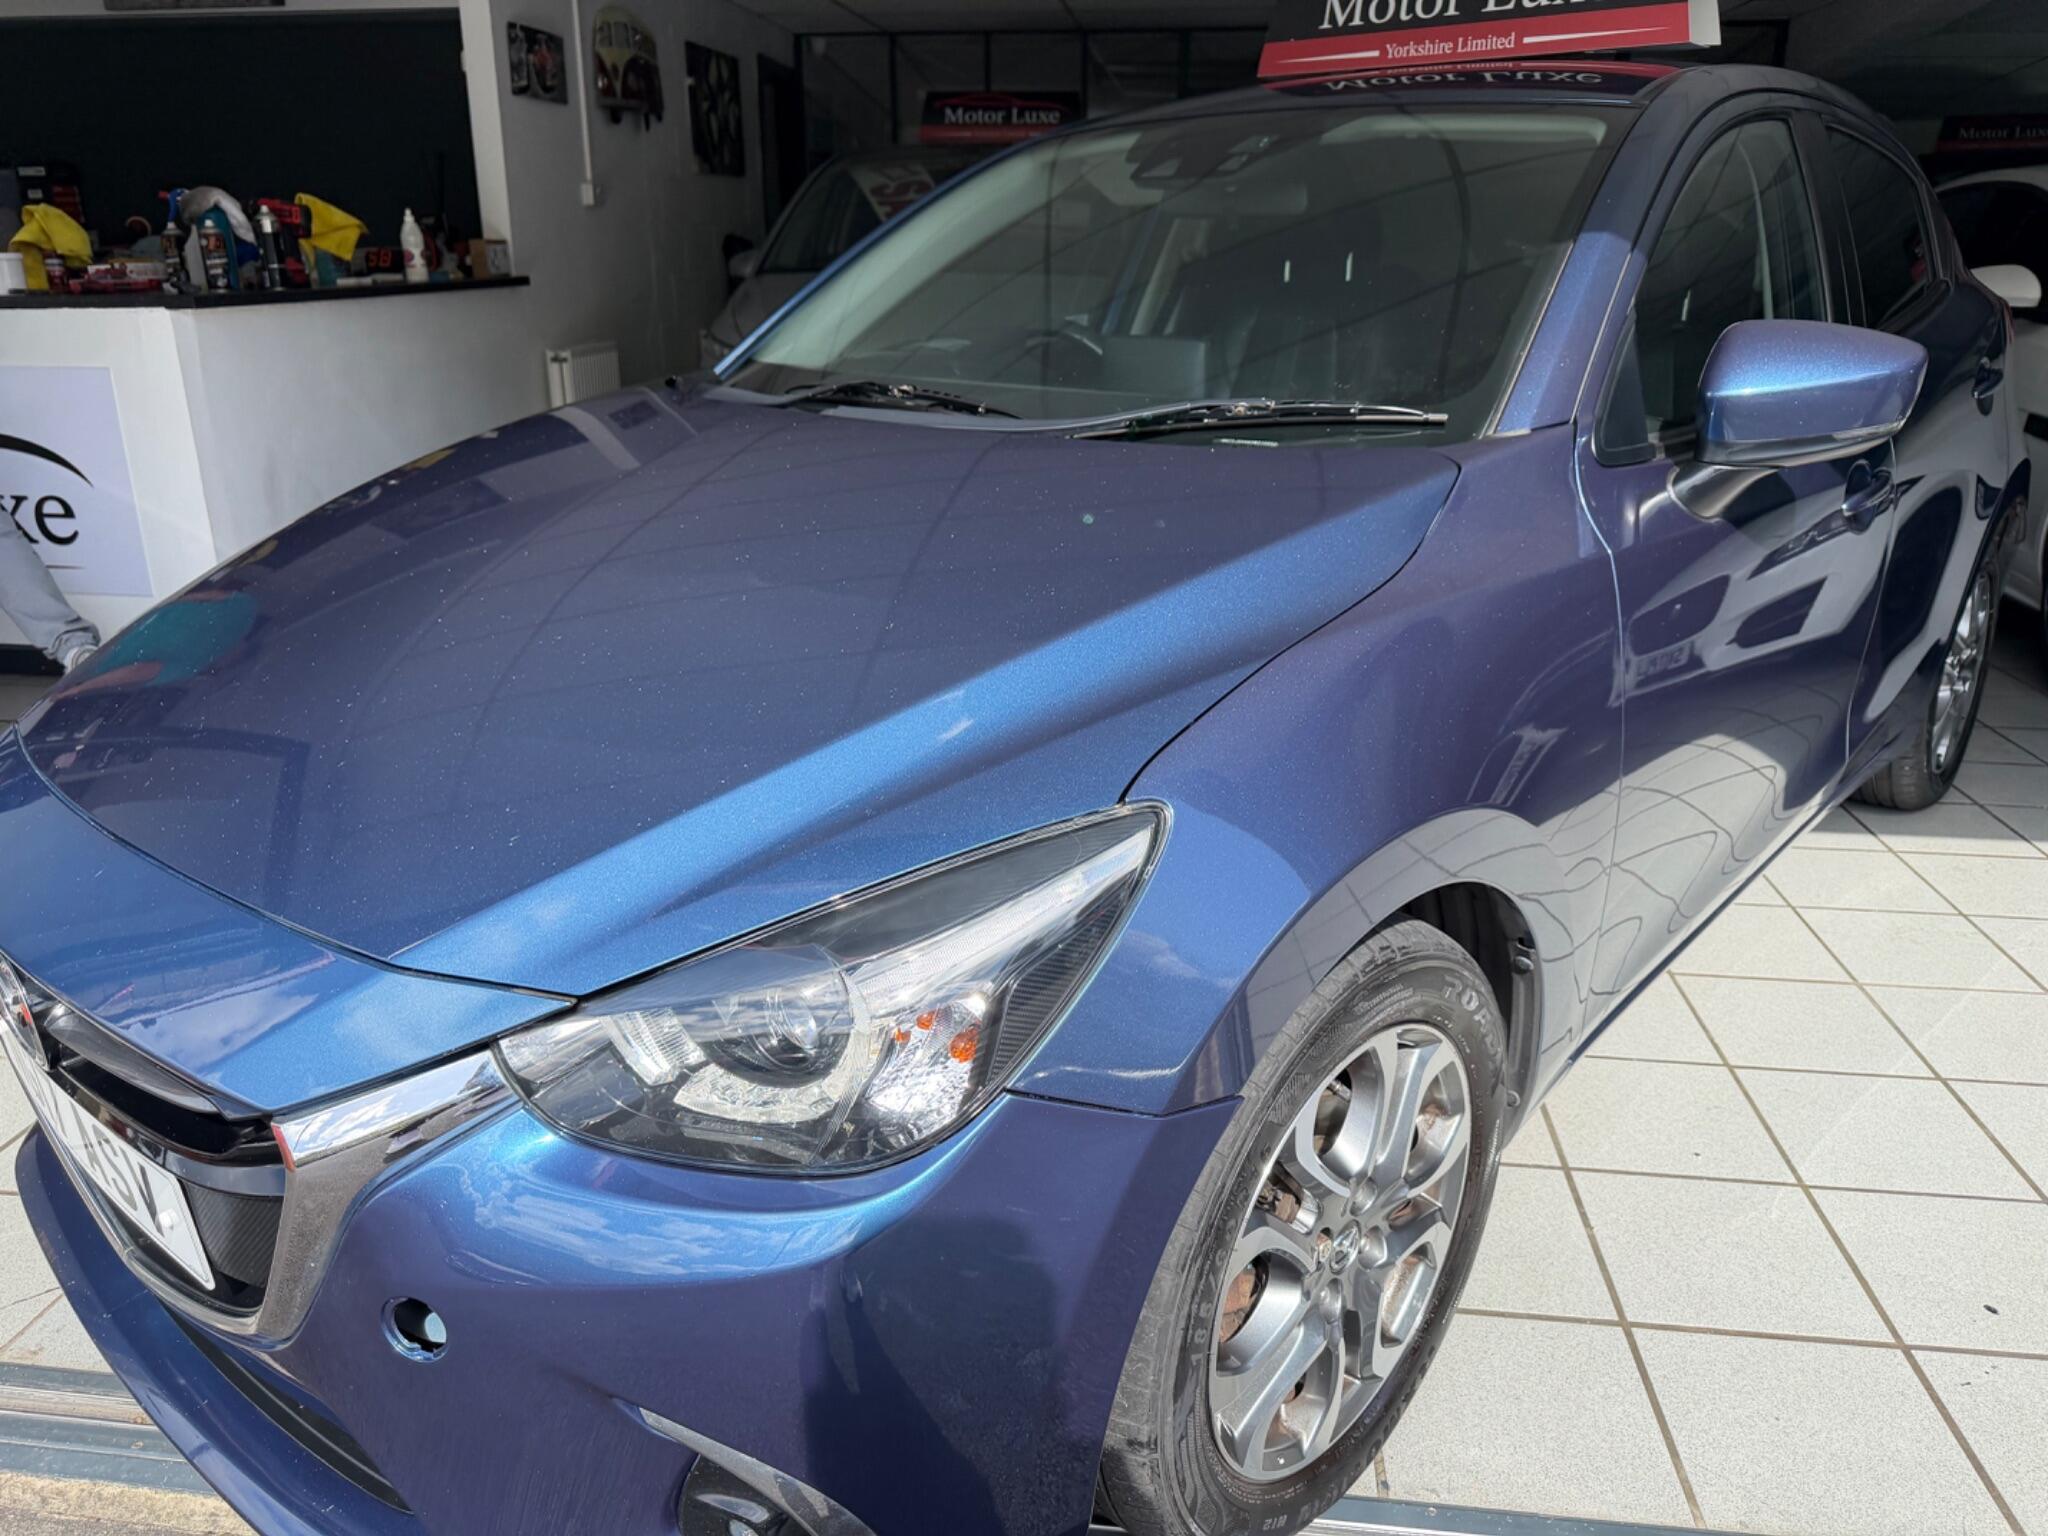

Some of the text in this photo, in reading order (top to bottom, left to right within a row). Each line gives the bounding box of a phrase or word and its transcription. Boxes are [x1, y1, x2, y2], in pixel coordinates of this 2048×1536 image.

[1386, 32, 1516, 59] Yorkshire Limited
[944, 106, 1061, 125] Motor Luxe
[1958, 125, 2048, 140] Motor Lux
